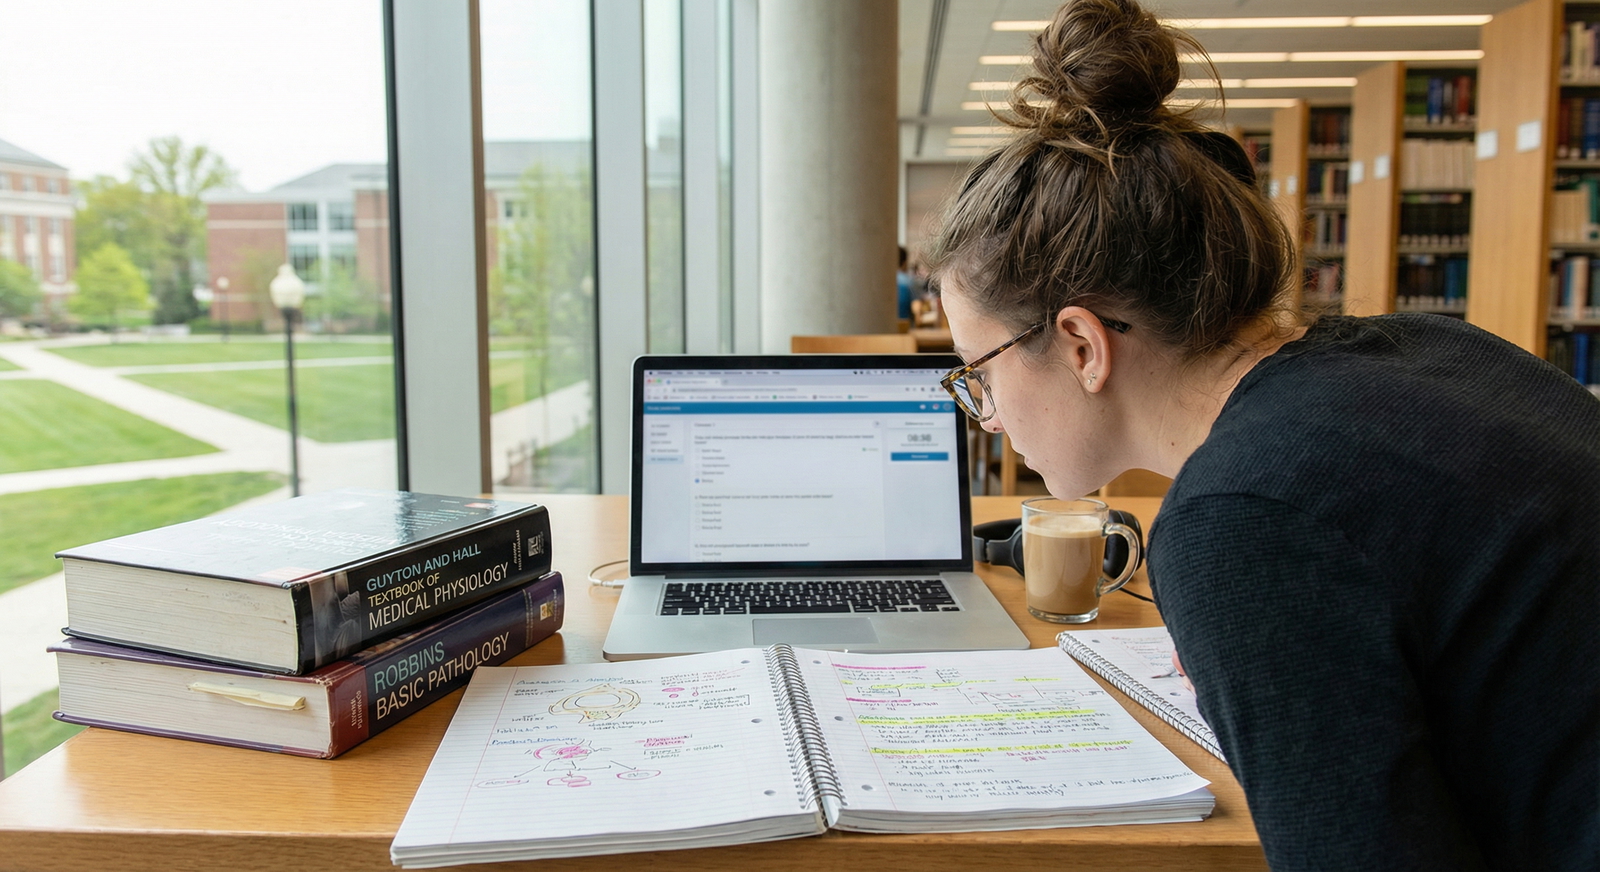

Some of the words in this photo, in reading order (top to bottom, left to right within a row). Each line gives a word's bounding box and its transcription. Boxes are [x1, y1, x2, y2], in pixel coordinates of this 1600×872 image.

[366, 564, 422, 592] GUYTON
[424, 553, 451, 573] AND
[452, 543, 482, 562] HALL
[367, 578, 425, 607] TEXTBOOK
[426, 572, 440, 587] OF
[368, 592, 431, 630] MEDICAL
[434, 562, 509, 605] PHYSIOLOGY
[373, 641, 445, 694] ROBBINS
[375, 677, 425, 720] BASIC
[428, 631, 510, 691] PATHOLOGY
